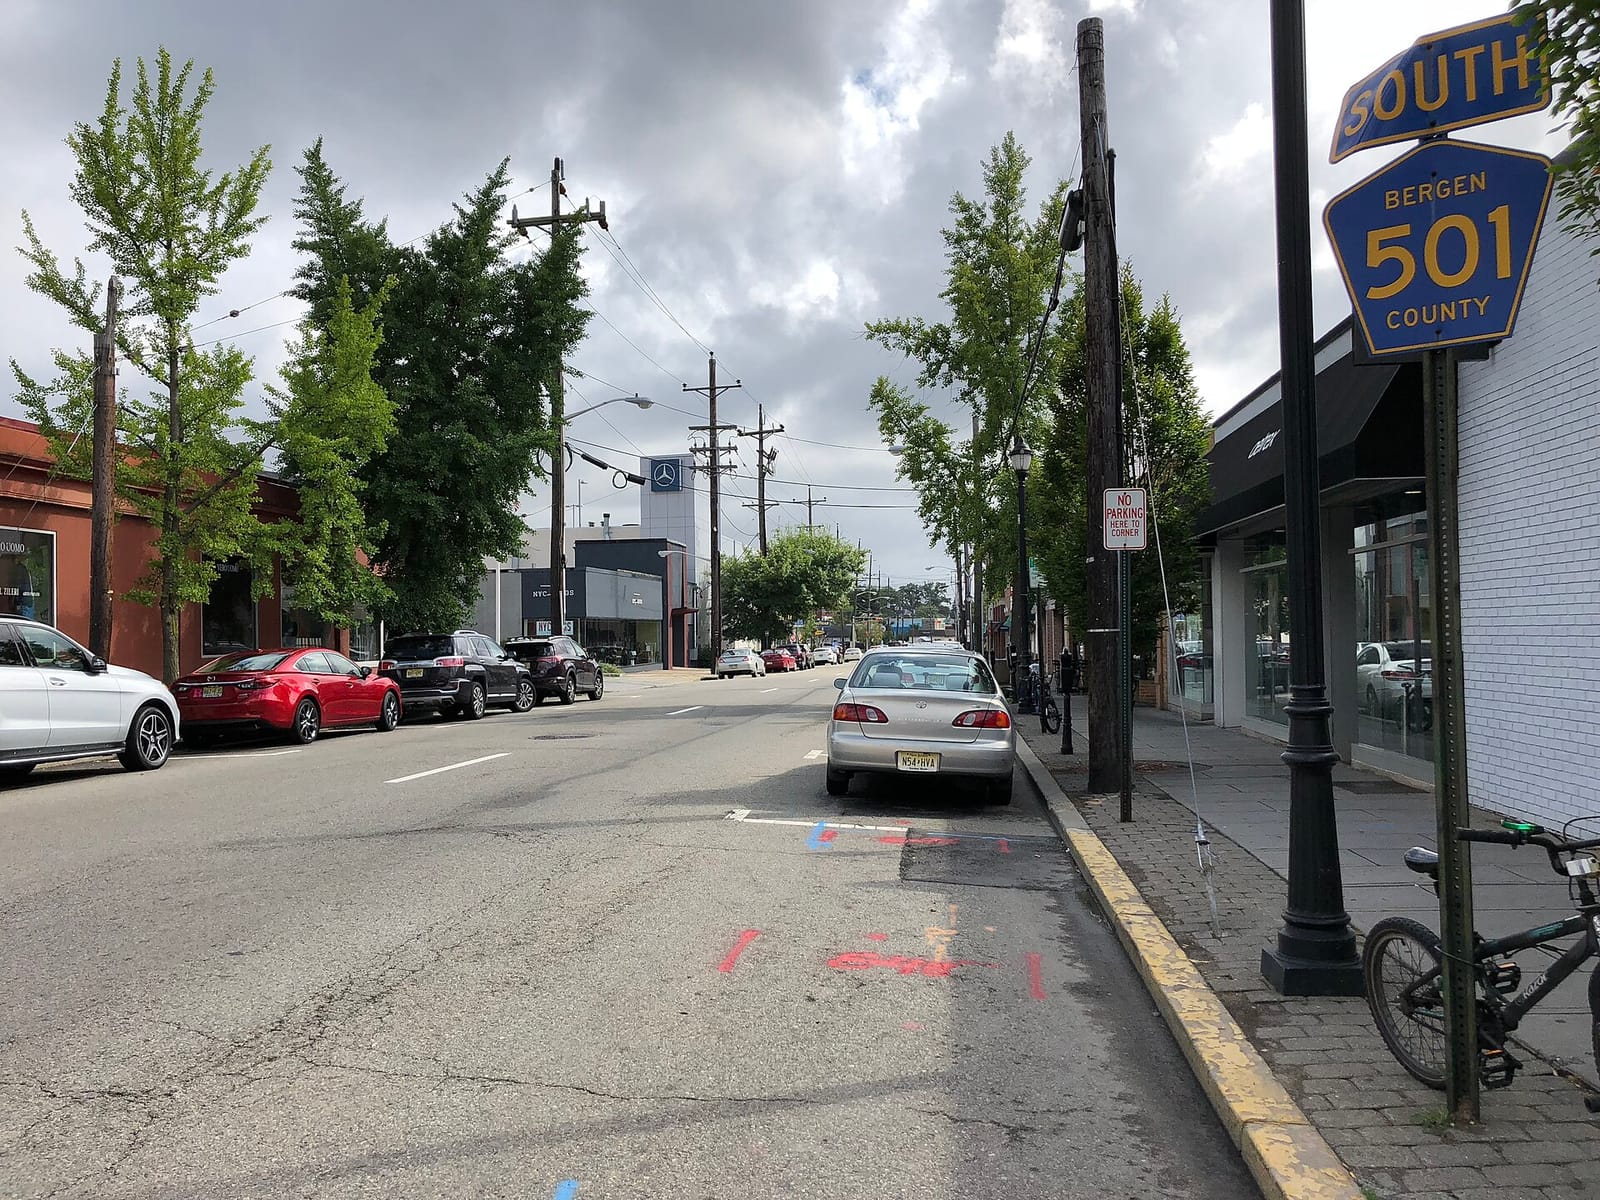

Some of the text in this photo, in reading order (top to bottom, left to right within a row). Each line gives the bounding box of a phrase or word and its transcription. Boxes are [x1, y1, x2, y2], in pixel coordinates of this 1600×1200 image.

[1344, 34, 1529, 138] SOUTH
[1385, 171, 1487, 210] BERGEN
[1365, 204, 1512, 300] 501
[1386, 295, 1490, 330] COUNTY
[1117, 494, 1132, 506] NO
[1106, 507, 1143, 519] PARKING
[1110, 519, 1140, 528] HERE TO
[1111, 528, 1139, 537] CORNER
[6, 542, 25, 553] UOMO
